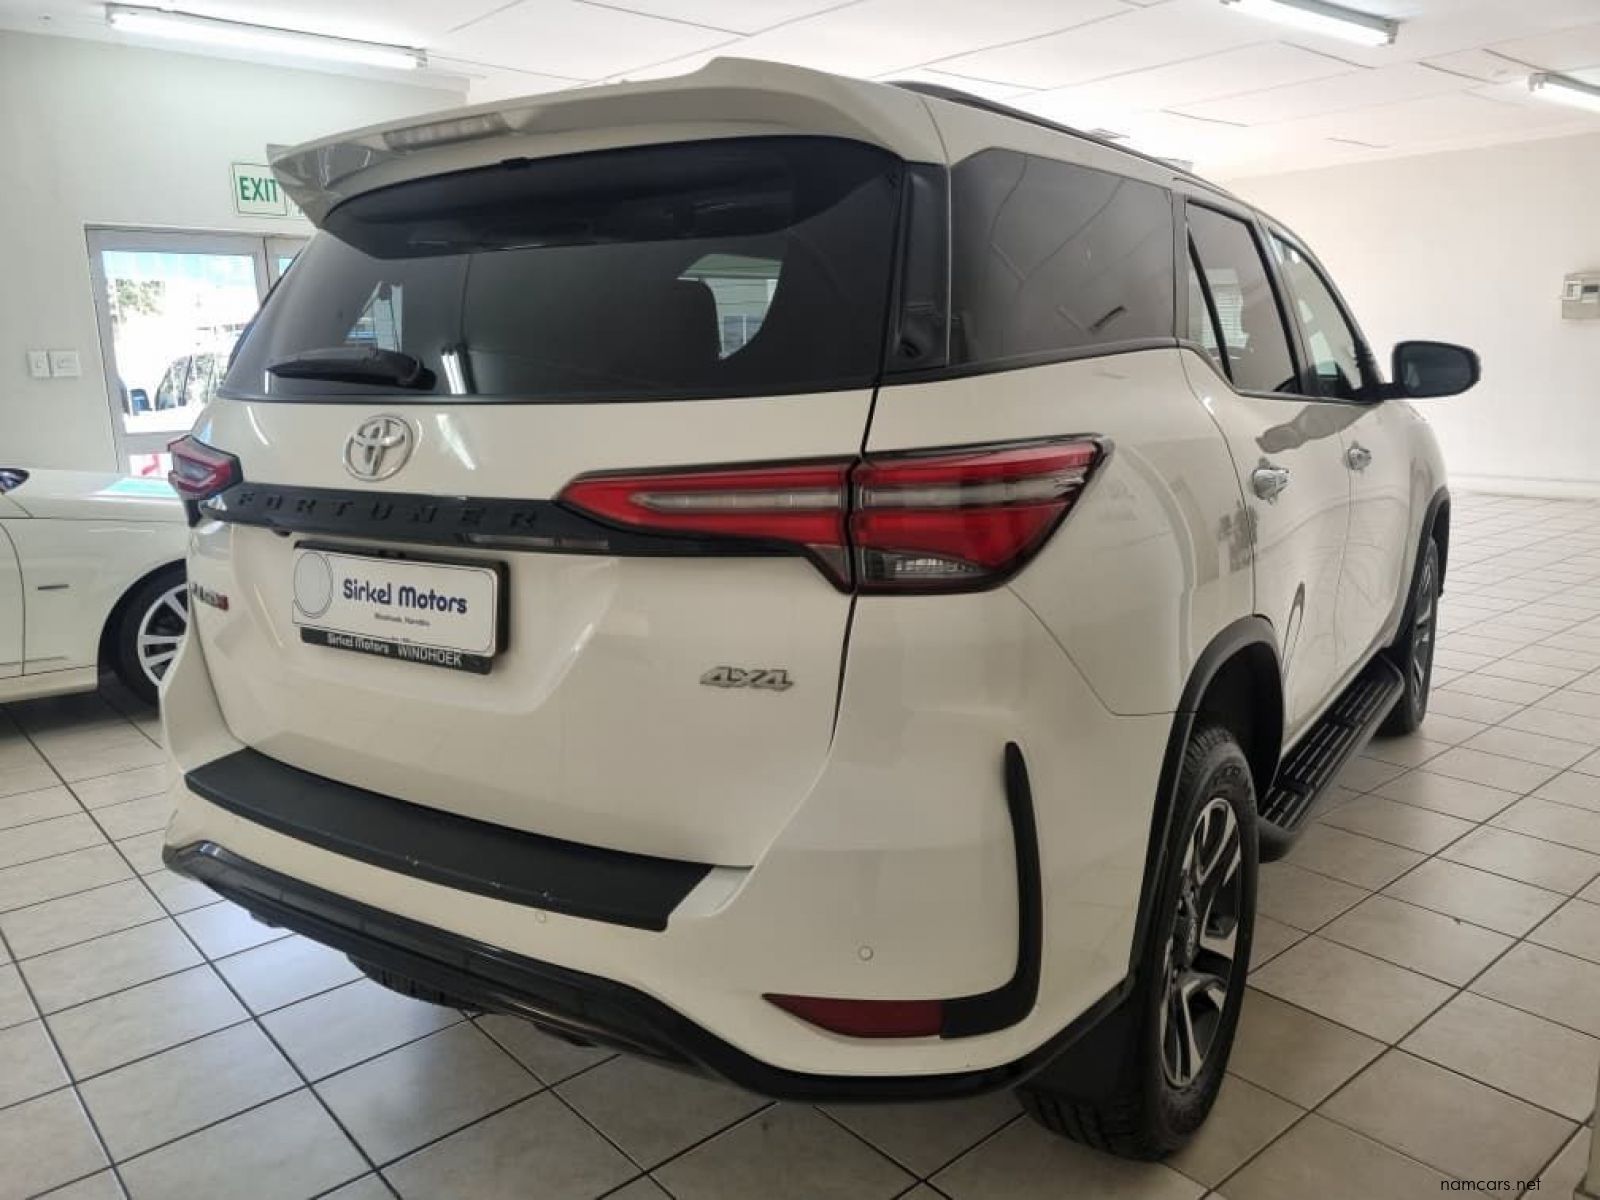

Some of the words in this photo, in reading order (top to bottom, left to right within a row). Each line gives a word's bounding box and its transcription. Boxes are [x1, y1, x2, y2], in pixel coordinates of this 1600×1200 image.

[239, 177, 278, 203] EXIT
[238, 492, 538, 529] FORTUNER
[343, 578, 392, 605] Sirkel
[399, 585, 468, 614] Motors
[398, 645, 463, 667] WINDHOEK
